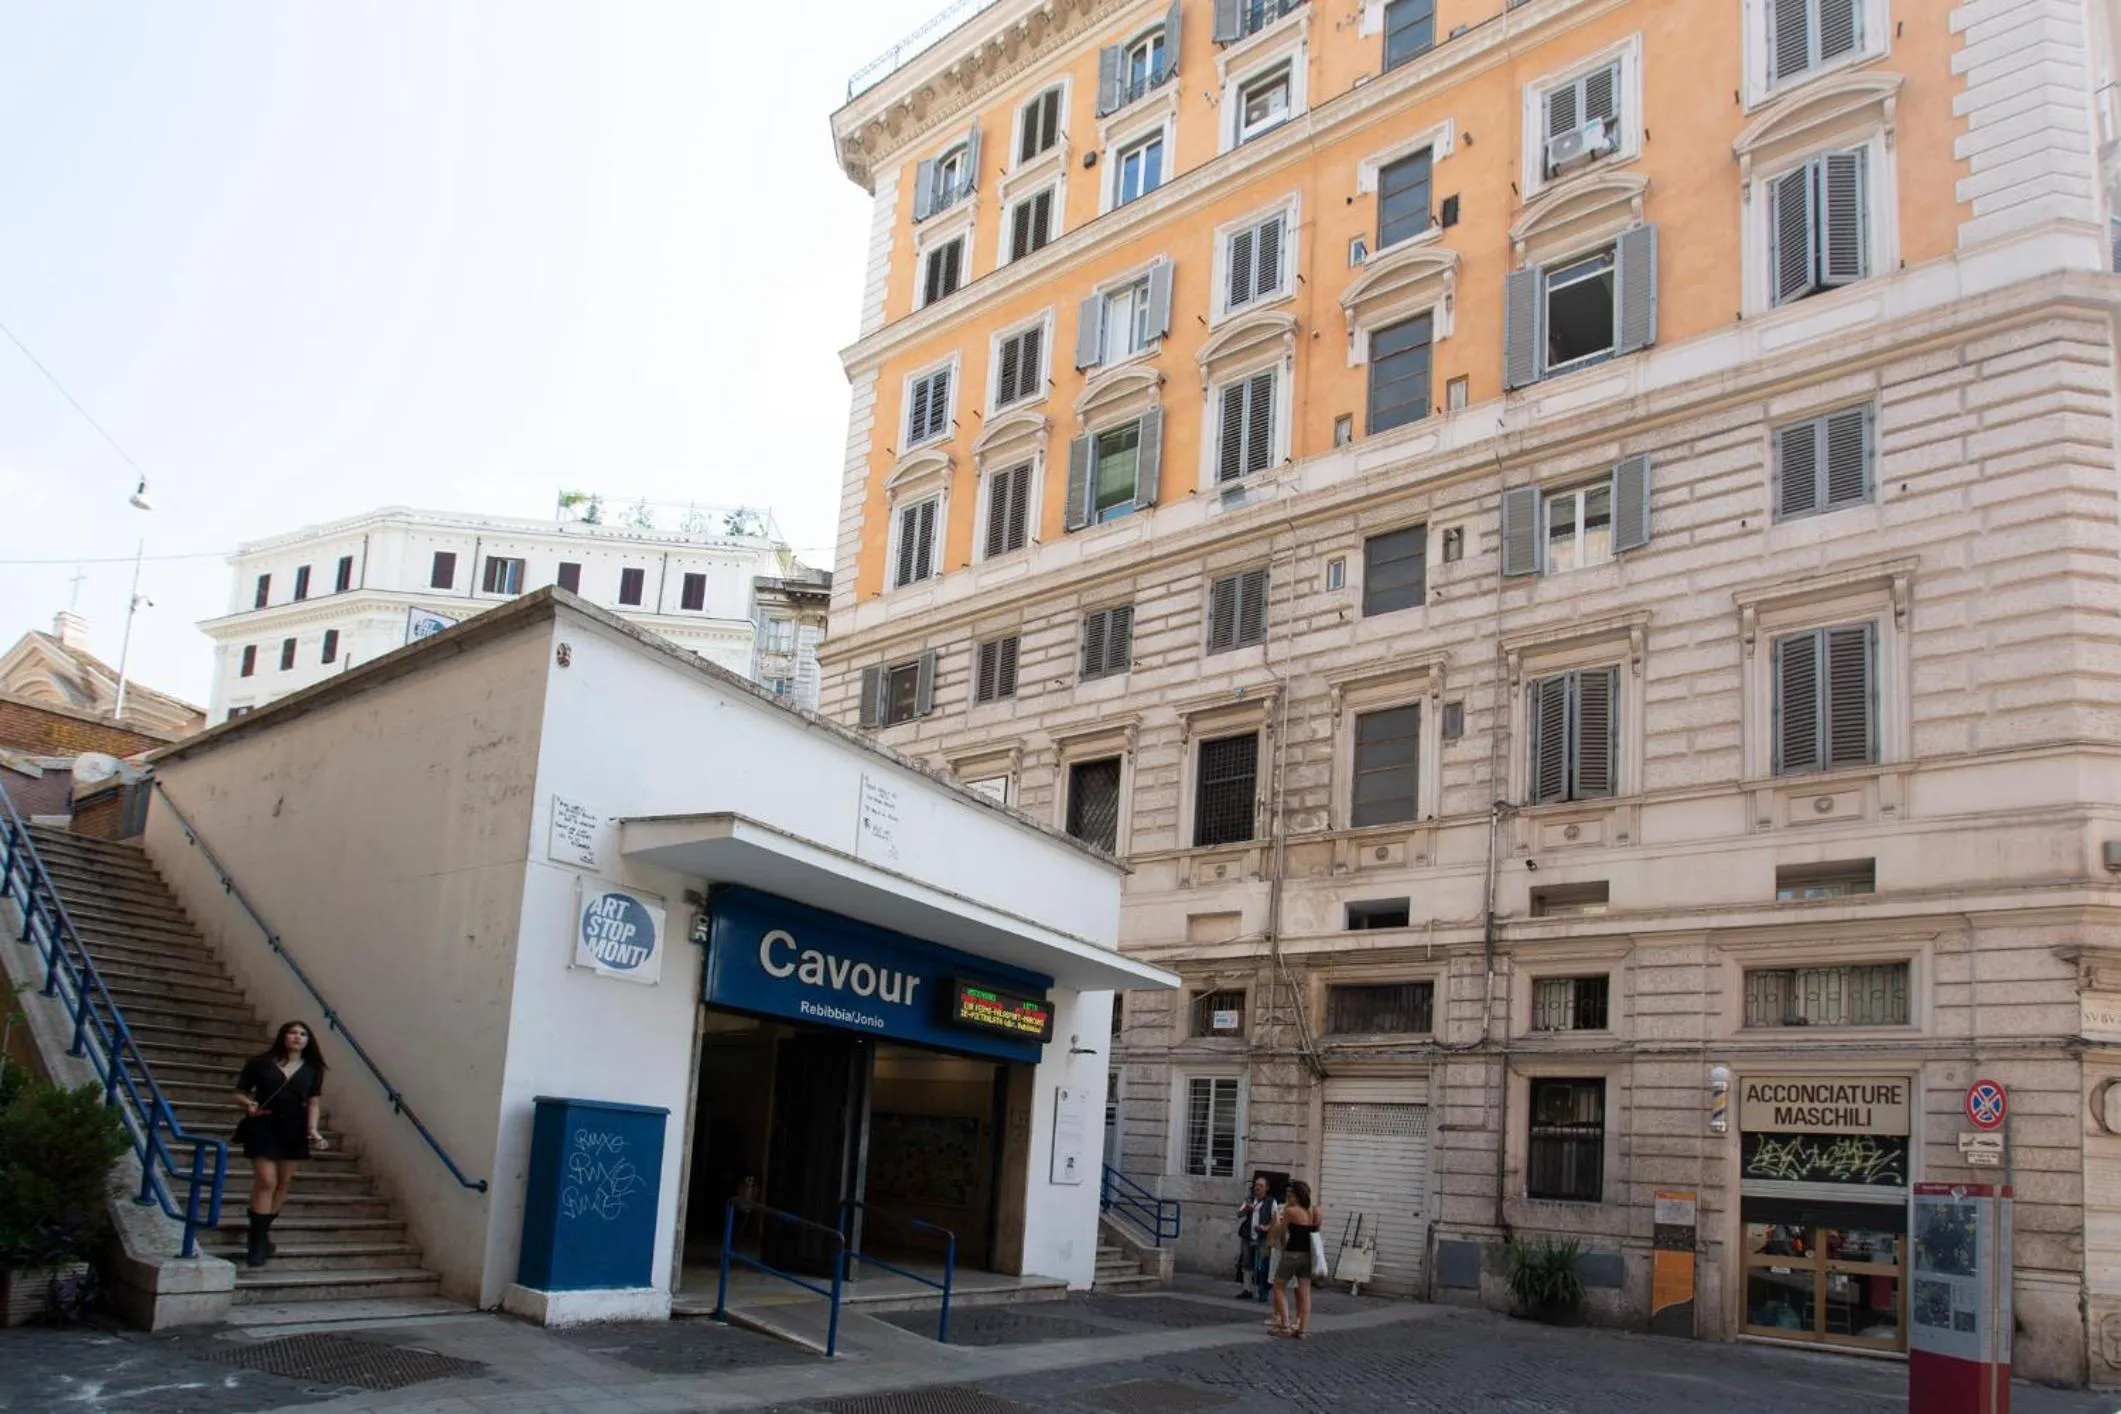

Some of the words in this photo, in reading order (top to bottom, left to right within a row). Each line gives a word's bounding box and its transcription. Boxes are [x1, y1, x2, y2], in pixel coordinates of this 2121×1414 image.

[589, 897, 630, 920] ART
[587, 915, 637, 942] STOP
[587, 936, 649, 966] MONTI
[759, 929, 921, 1006] Cavour
[800, 1000, 885, 1029] Rebibbia/Jonio
[1746, 1084, 1903, 1105] ACCONCIATURE
[1774, 1107, 1872, 1127] MASCHILI
